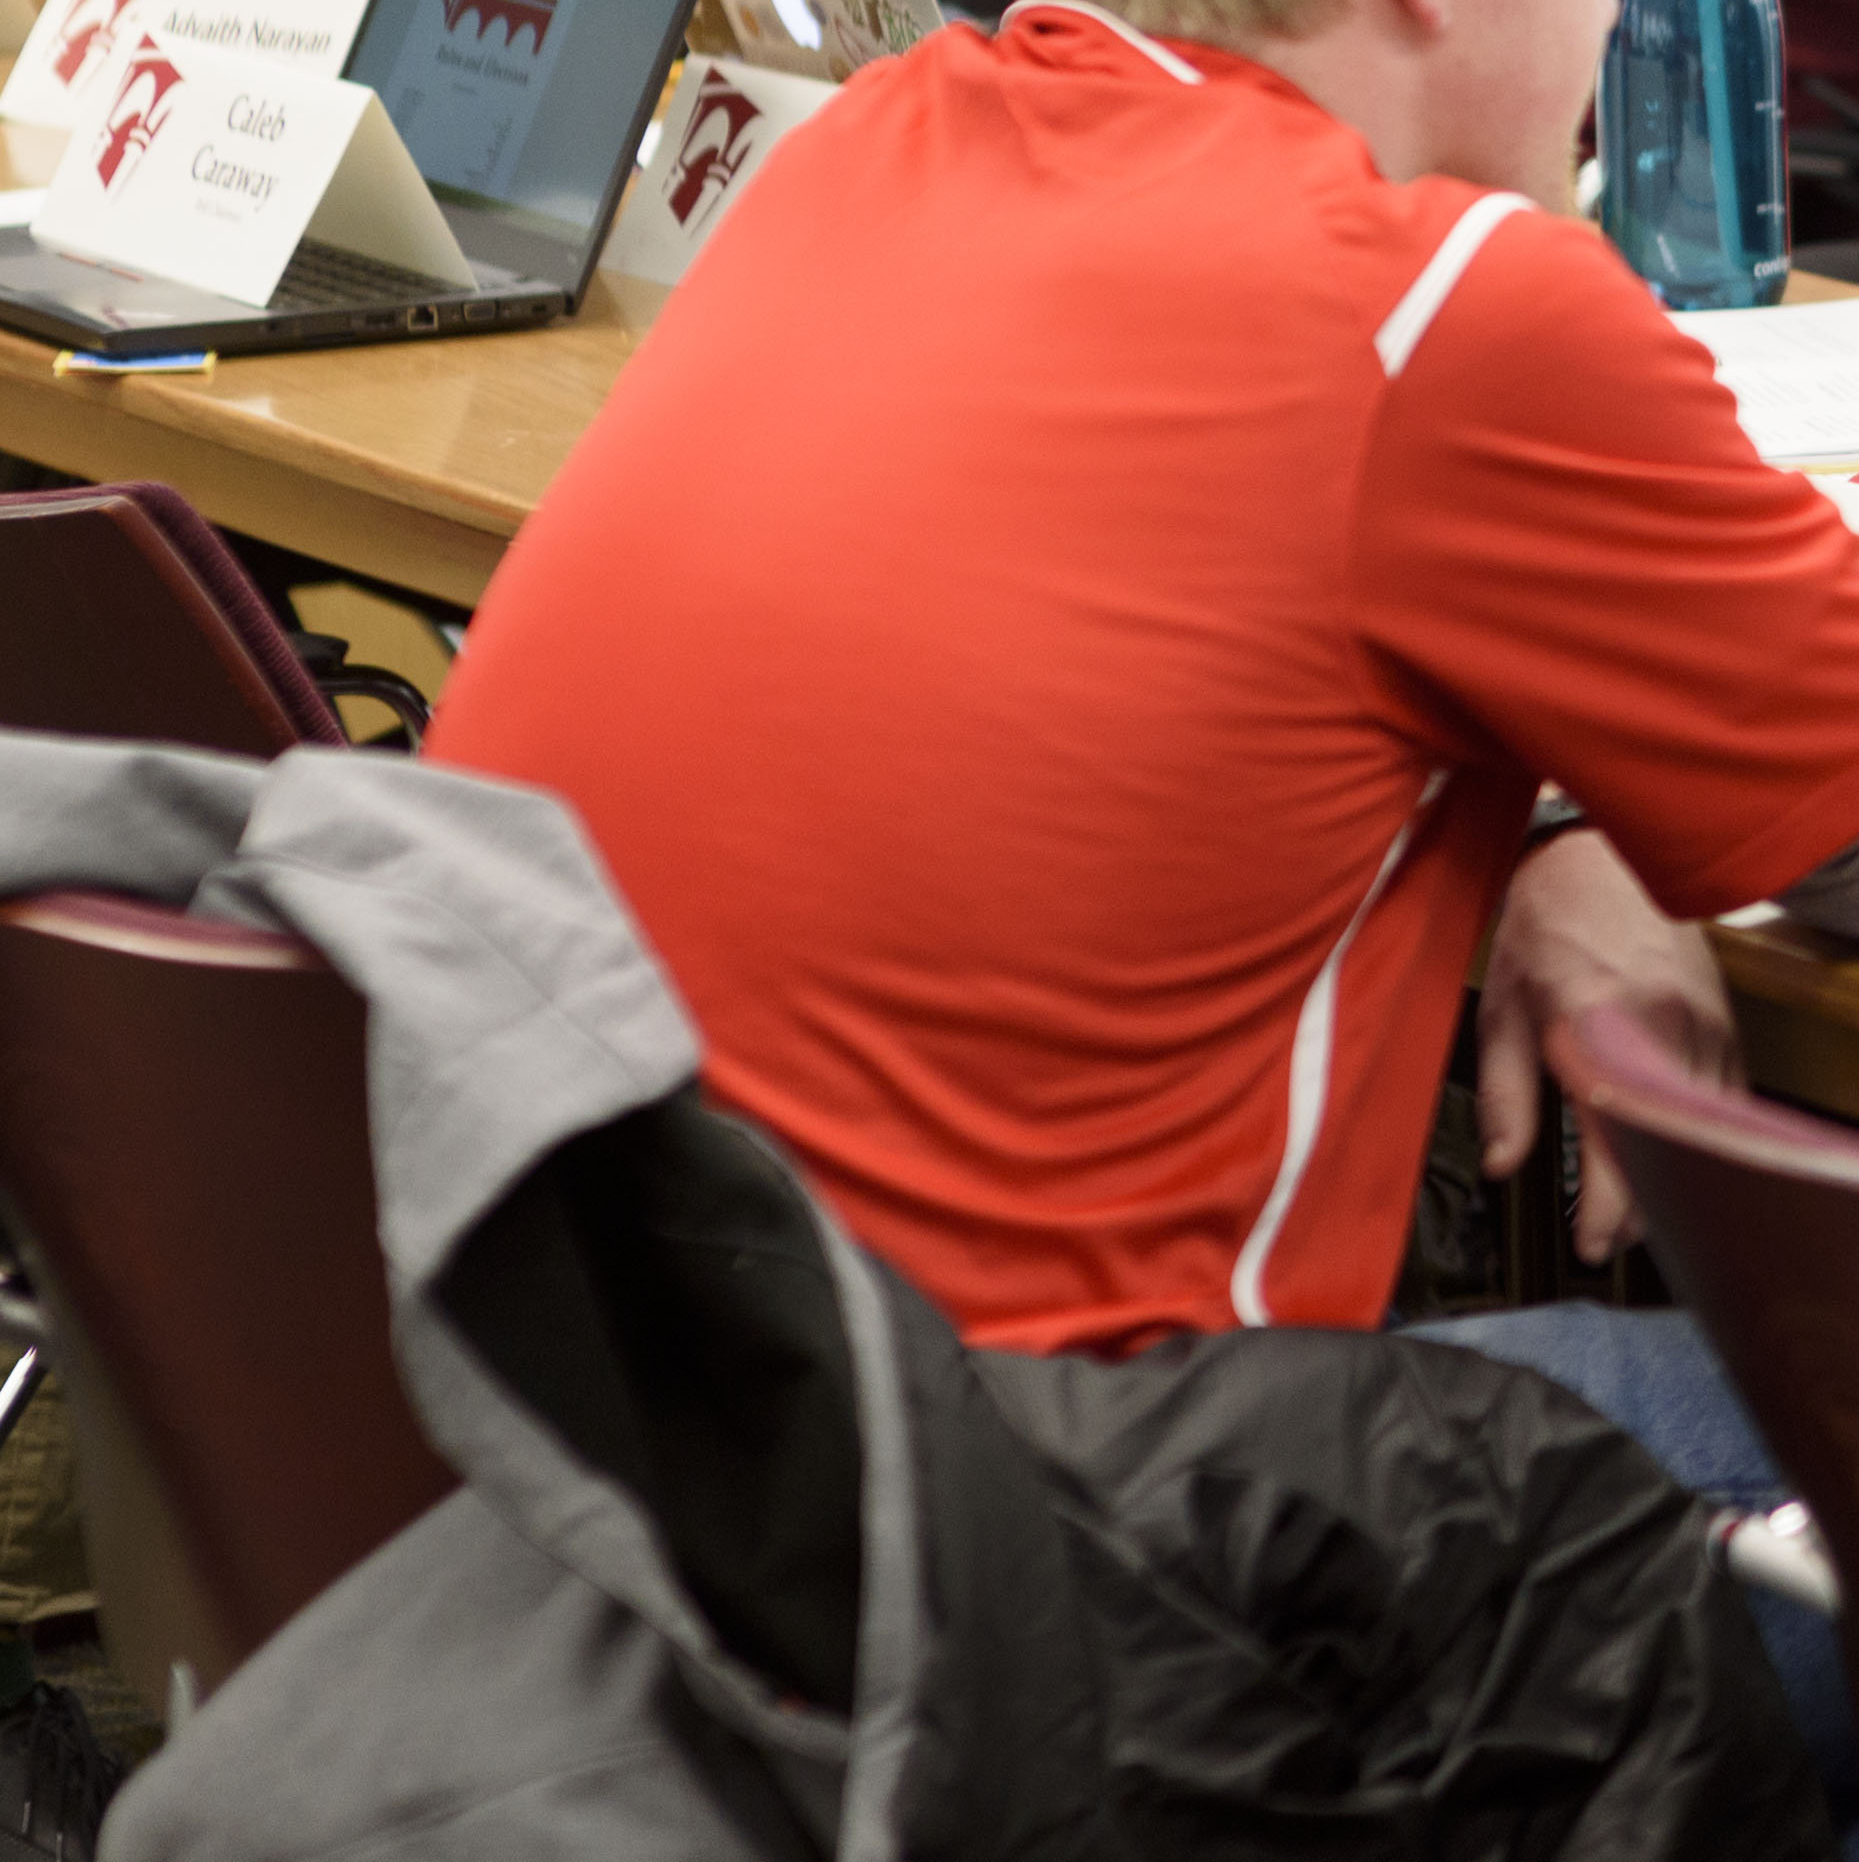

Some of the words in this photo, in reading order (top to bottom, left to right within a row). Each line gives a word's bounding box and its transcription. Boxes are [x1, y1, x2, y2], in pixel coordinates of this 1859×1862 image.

[163, 6, 242, 44] Advaith
[247, 18, 331, 55] Narayan
[228, 93, 286, 142] Caleb
[192, 144, 279, 213] Caraway
